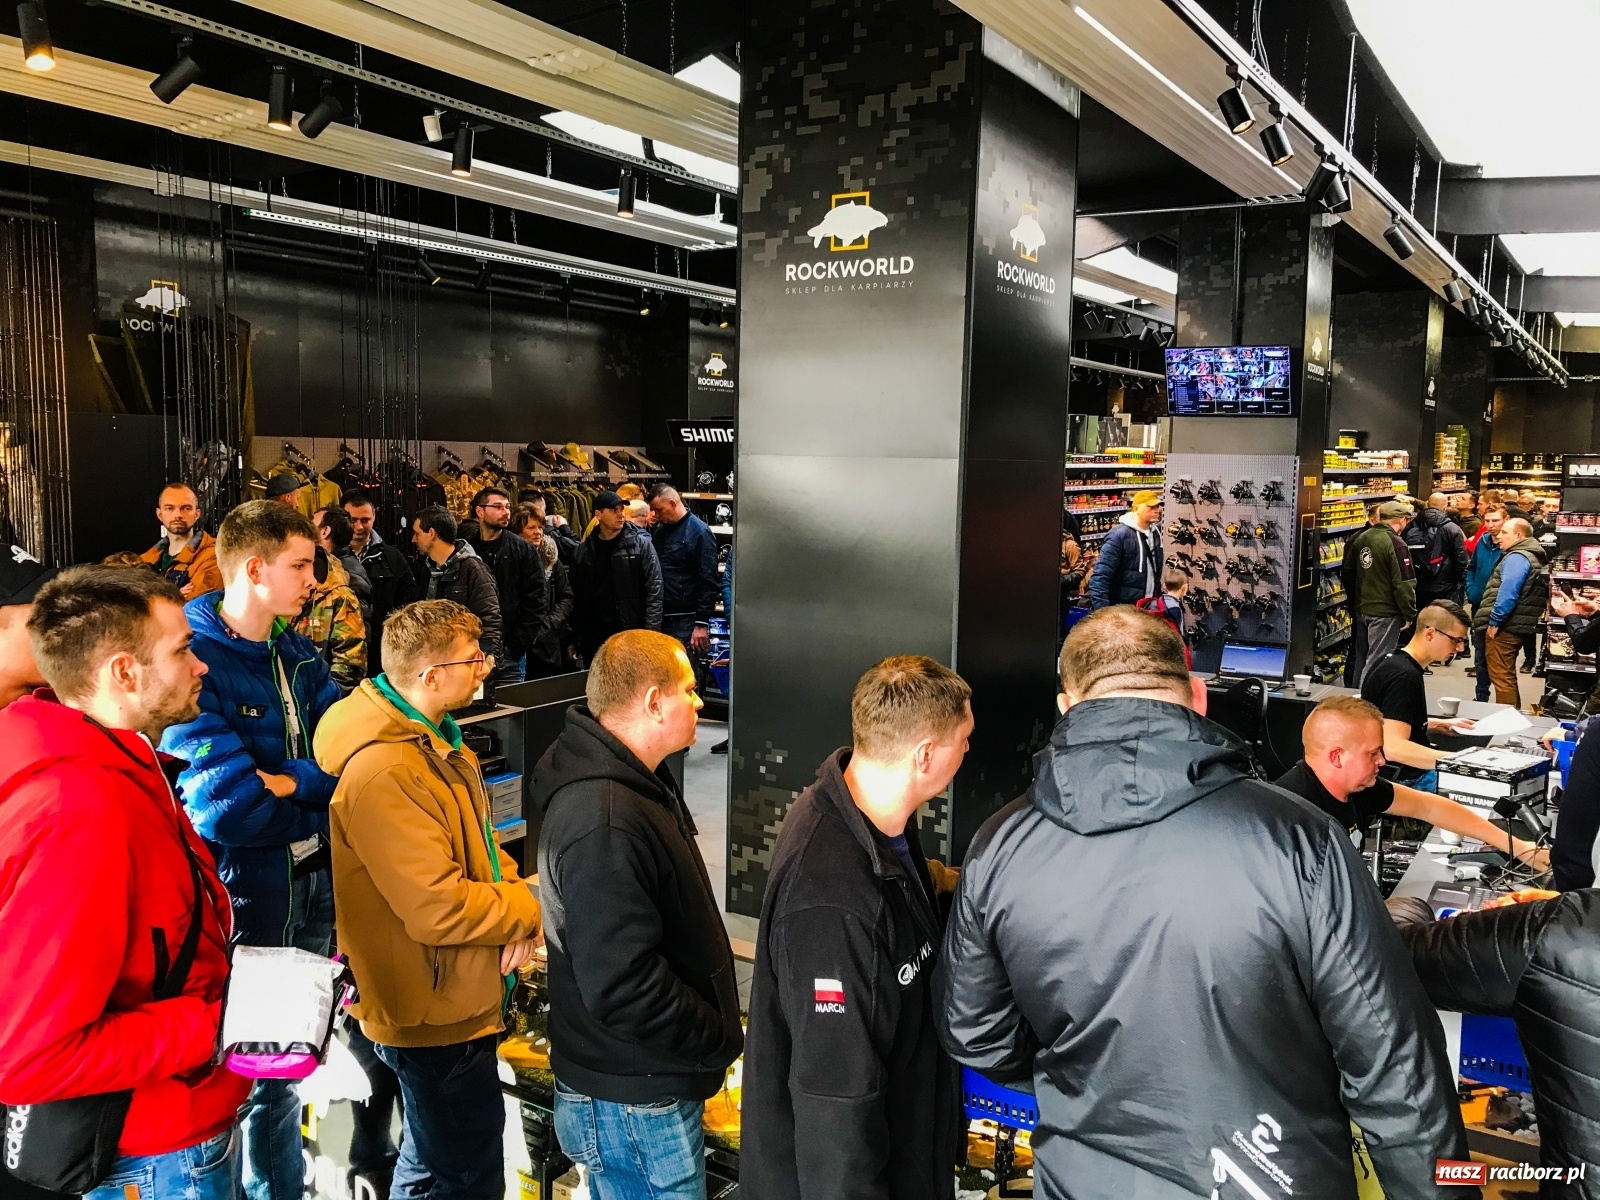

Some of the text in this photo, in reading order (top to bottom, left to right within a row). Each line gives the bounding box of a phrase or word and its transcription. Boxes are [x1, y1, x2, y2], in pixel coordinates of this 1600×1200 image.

[785, 256, 914, 282] ROCKWORLD
[997, 260, 1055, 294] ROCKWORLD
[785, 280, 914, 295] SKLEP DLA KARPIARZY
[697, 377, 735, 388] ROCKWORLD
